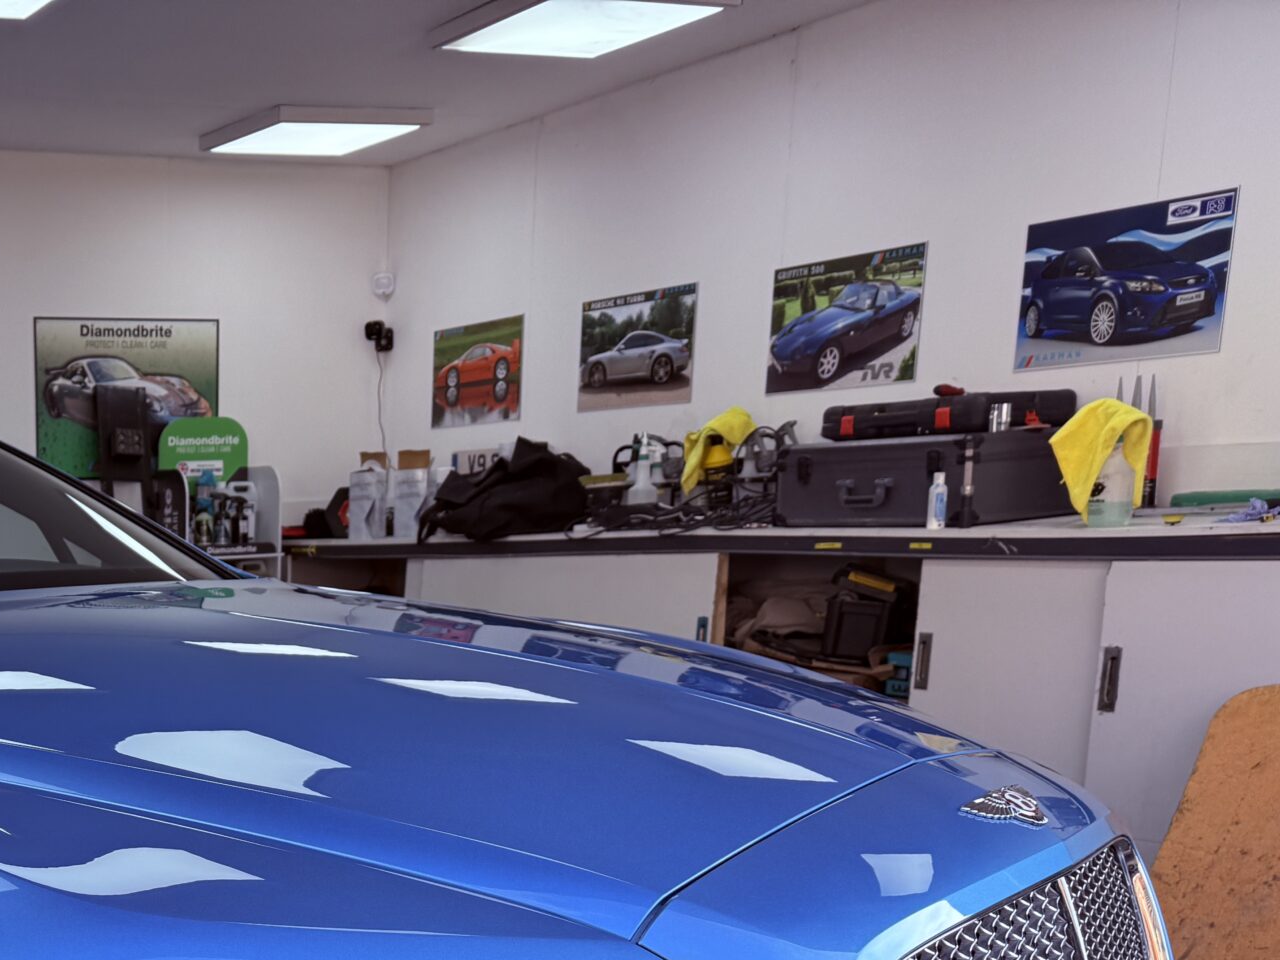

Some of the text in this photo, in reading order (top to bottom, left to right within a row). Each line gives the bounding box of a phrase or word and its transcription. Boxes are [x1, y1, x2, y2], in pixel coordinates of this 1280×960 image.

[80, 324, 172, 338] Diamondbrite
[861, 361, 895, 381] TVR
[167, 435, 240, 447] Diamondbrite
